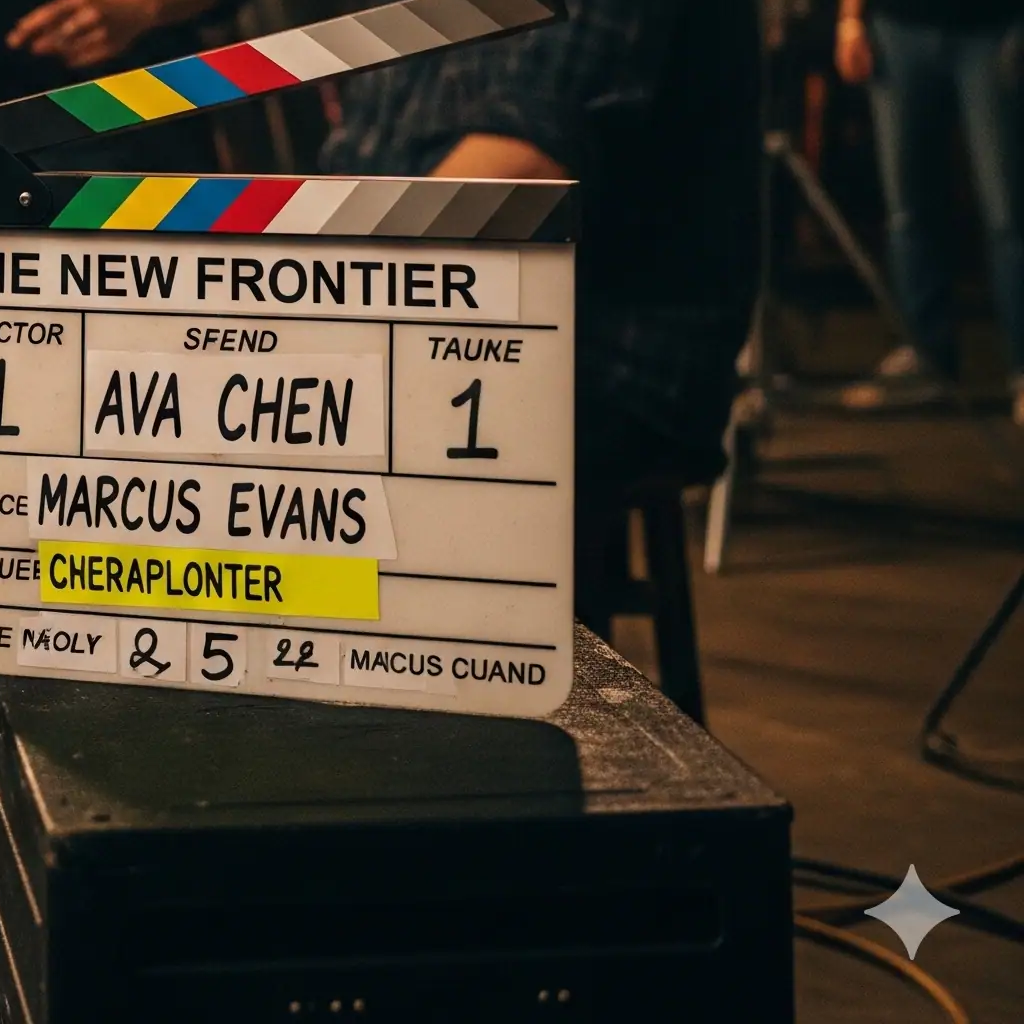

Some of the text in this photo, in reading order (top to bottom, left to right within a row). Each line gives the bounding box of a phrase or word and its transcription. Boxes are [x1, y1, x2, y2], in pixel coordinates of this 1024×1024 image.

[60, 253, 179, 300] NEW
[197, 256, 480, 309] FRONTIER
[183, 327, 278, 353] SFEND
[94, 369, 354, 447] AVA CHEN
[446, 378, 499, 460] 1
[38, 473, 367, 545] MARCUS EVANS
[49, 552, 284, 603] CHERAPLONTER
[200, 631, 239, 681] 5
[451, 657, 546, 686] CUAND
